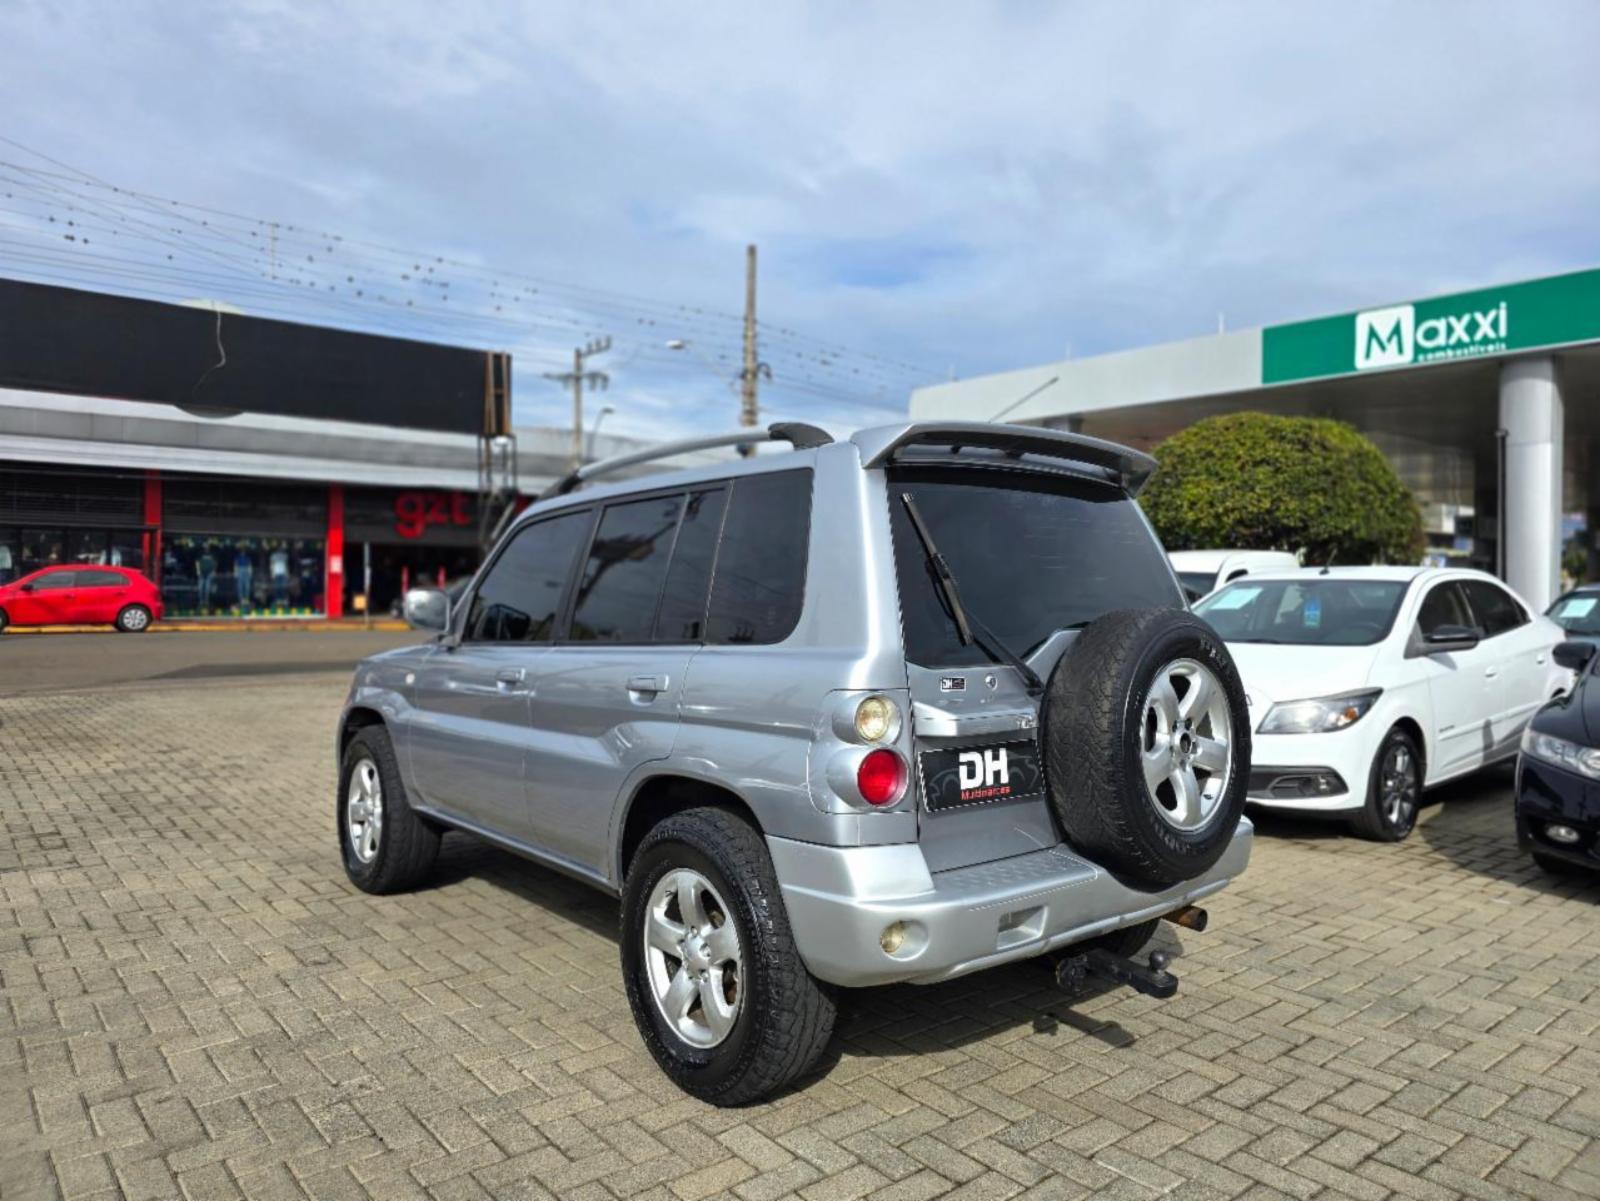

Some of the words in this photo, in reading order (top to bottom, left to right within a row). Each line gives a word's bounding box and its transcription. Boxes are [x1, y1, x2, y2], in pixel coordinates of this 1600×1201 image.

[1362, 301, 1507, 361] Maxxi
[393, 489, 472, 538] gzt
[959, 748, 1009, 789] DH
